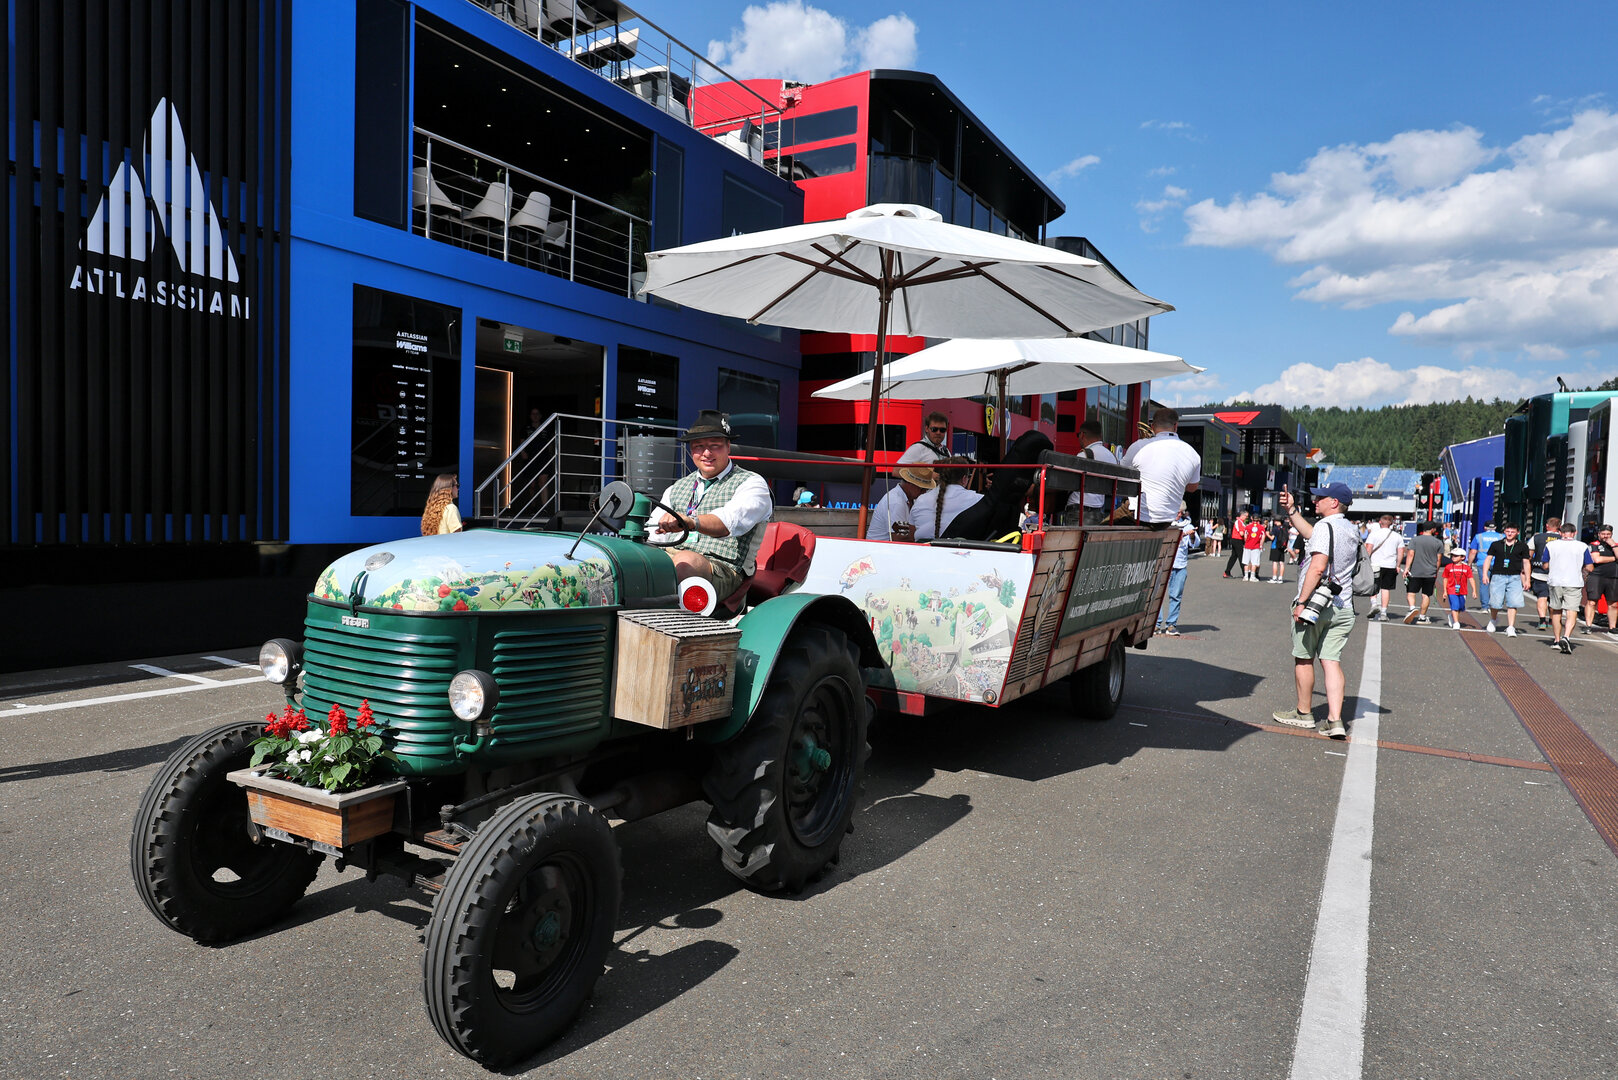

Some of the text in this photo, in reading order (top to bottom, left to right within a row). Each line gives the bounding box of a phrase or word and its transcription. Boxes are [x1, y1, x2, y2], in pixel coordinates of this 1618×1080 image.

[69, 264, 250, 320] ATLASSIAN
[401, 332, 428, 341] ATLASSIAN
[396, 340, 428, 353] Williams
